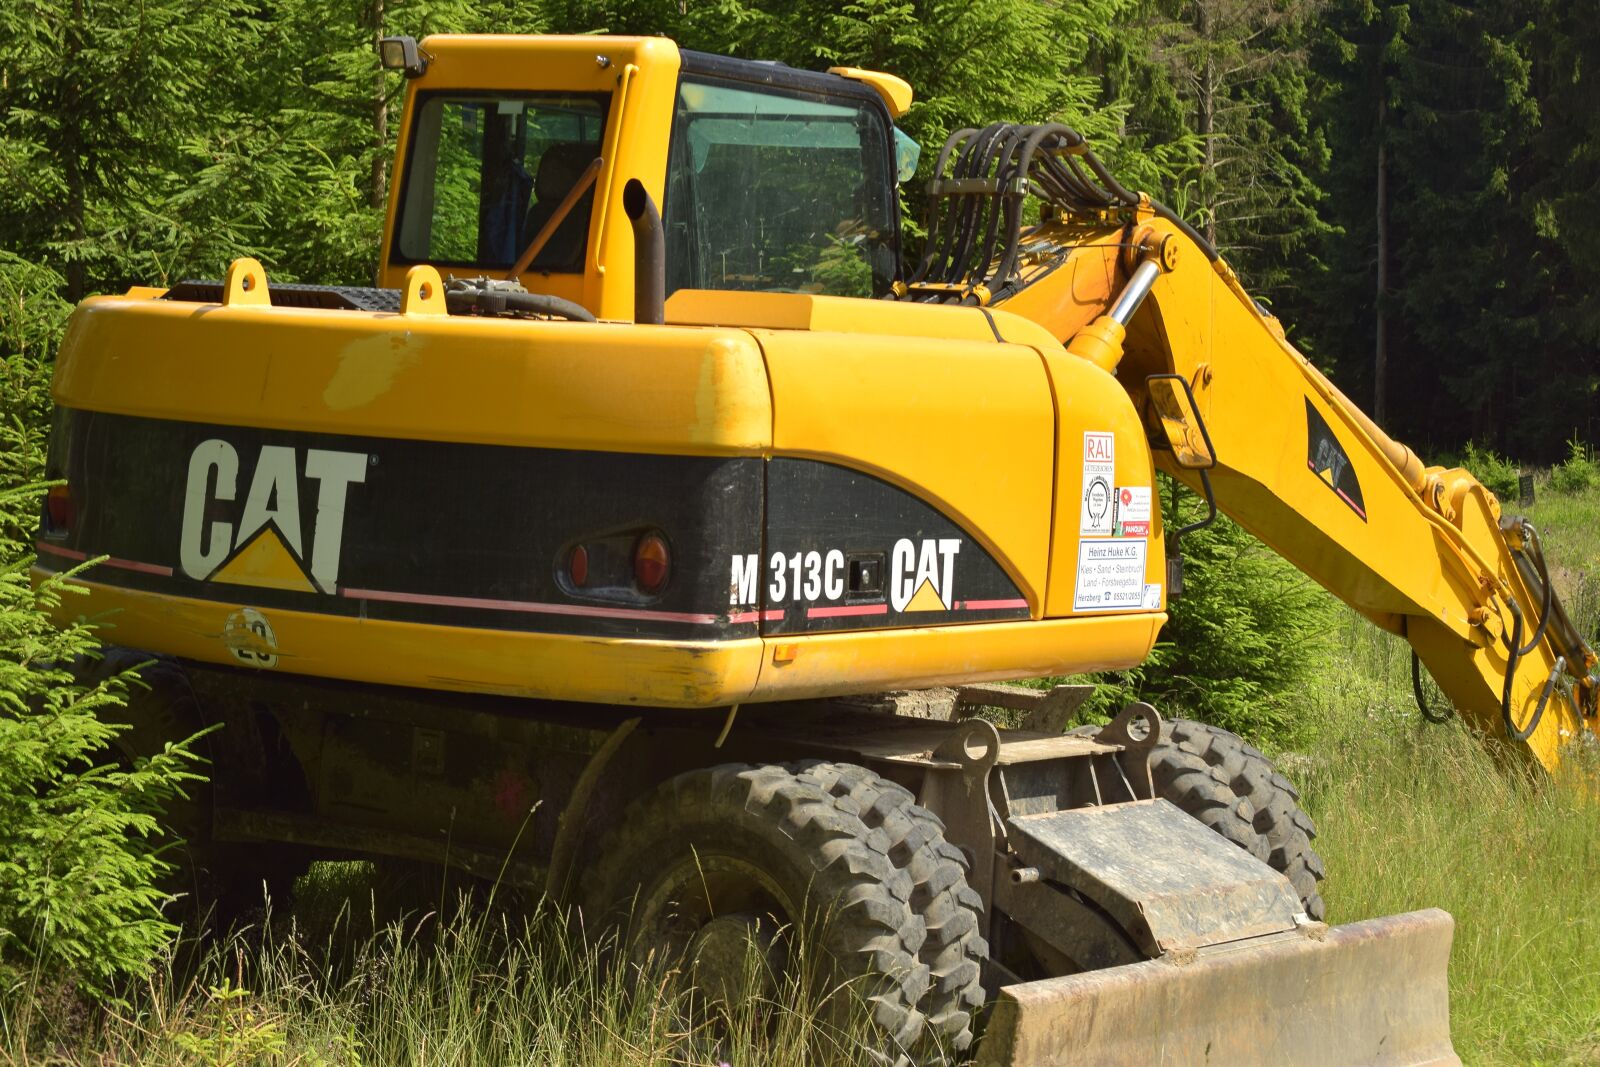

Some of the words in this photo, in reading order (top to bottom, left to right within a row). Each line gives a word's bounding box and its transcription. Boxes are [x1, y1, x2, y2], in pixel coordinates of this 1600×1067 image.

[1087, 438, 1111, 459] RAL
[1315, 438, 1348, 488] CAT
[180, 438, 369, 596] CAT
[1080, 565, 1093, 575] Kies
[1097, 564, 1112, 574] Sand
[1115, 563, 1143, 574] Steinbruch
[1088, 546, 1107, 557] Heinz
[1107, 546, 1124, 557] Huke
[729, 554, 759, 605] M
[769, 549, 844, 602] 313C
[890, 538, 961, 612] CAT
[1077, 593, 1102, 603] Herzberg
